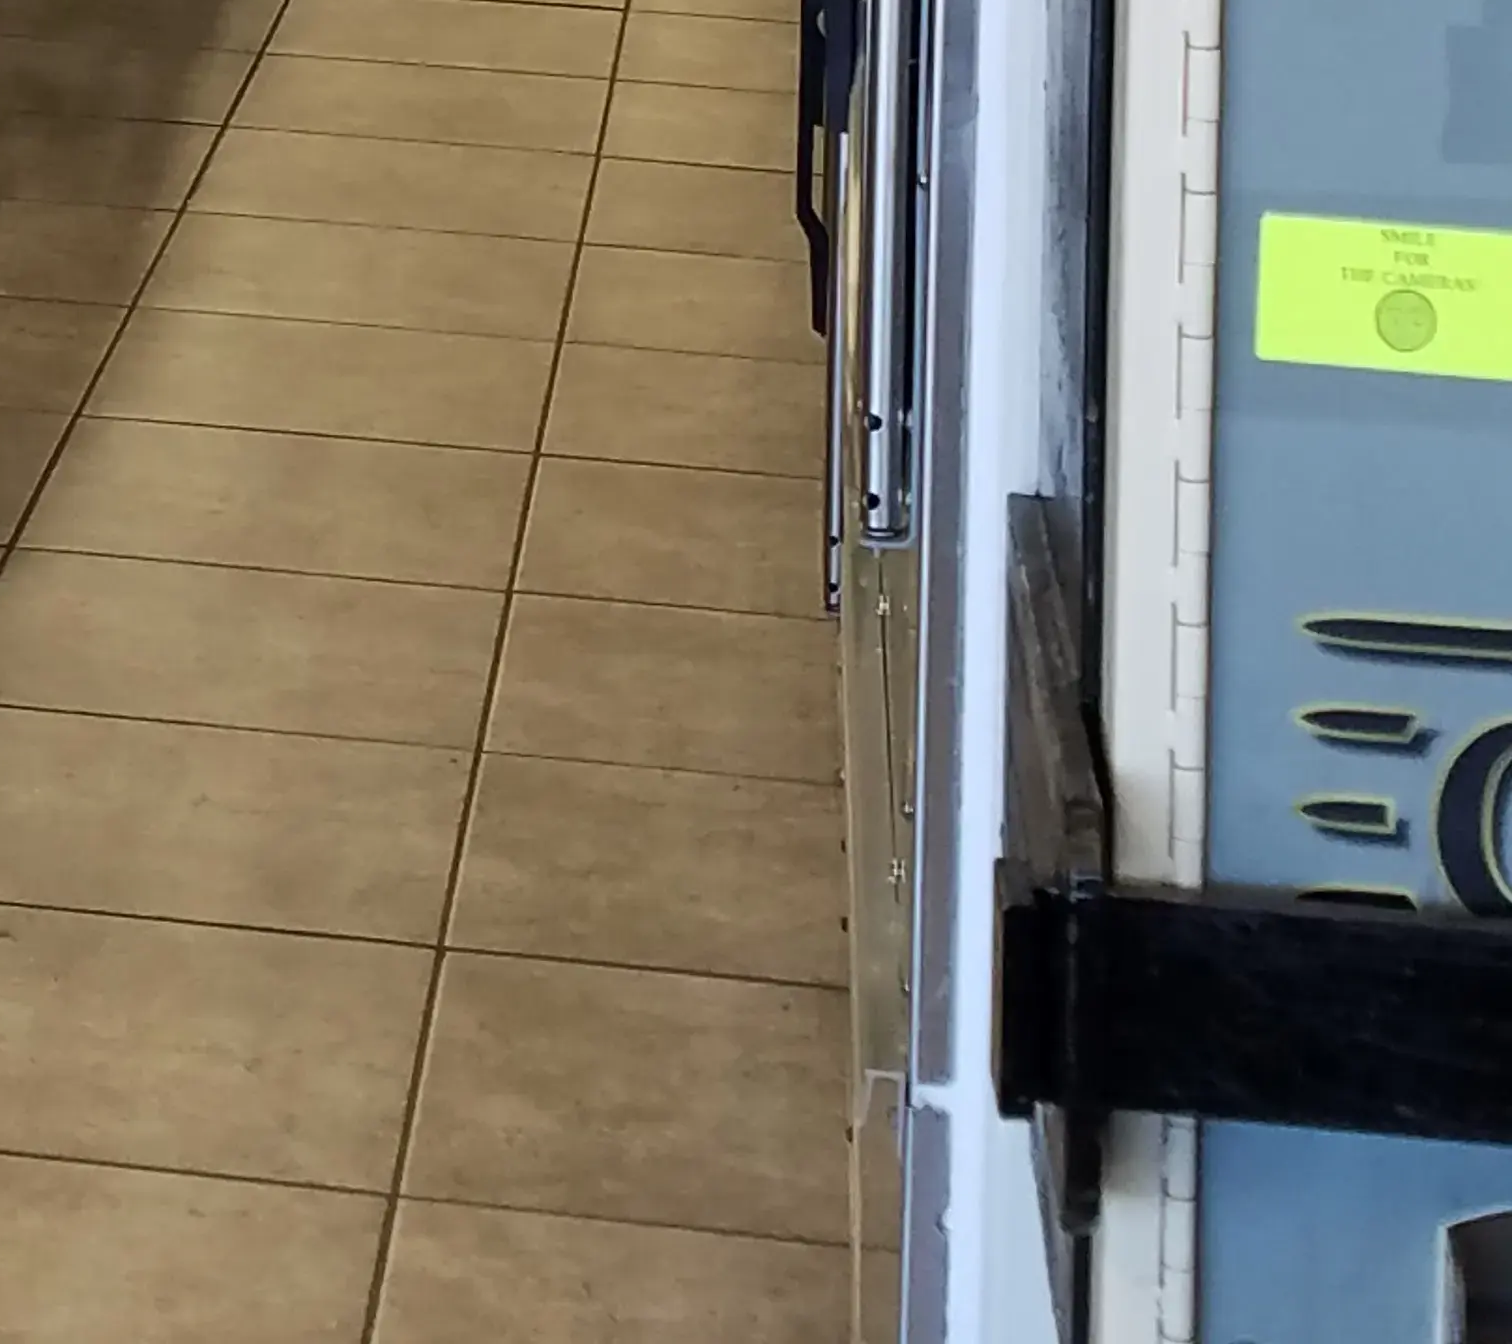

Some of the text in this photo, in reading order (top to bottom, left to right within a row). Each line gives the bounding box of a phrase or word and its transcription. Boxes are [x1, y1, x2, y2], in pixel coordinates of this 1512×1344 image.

[1380, 228, 1436, 247] SMILE
[1394, 250, 1430, 267] FOR
[1341, 266, 1375, 283] THE
